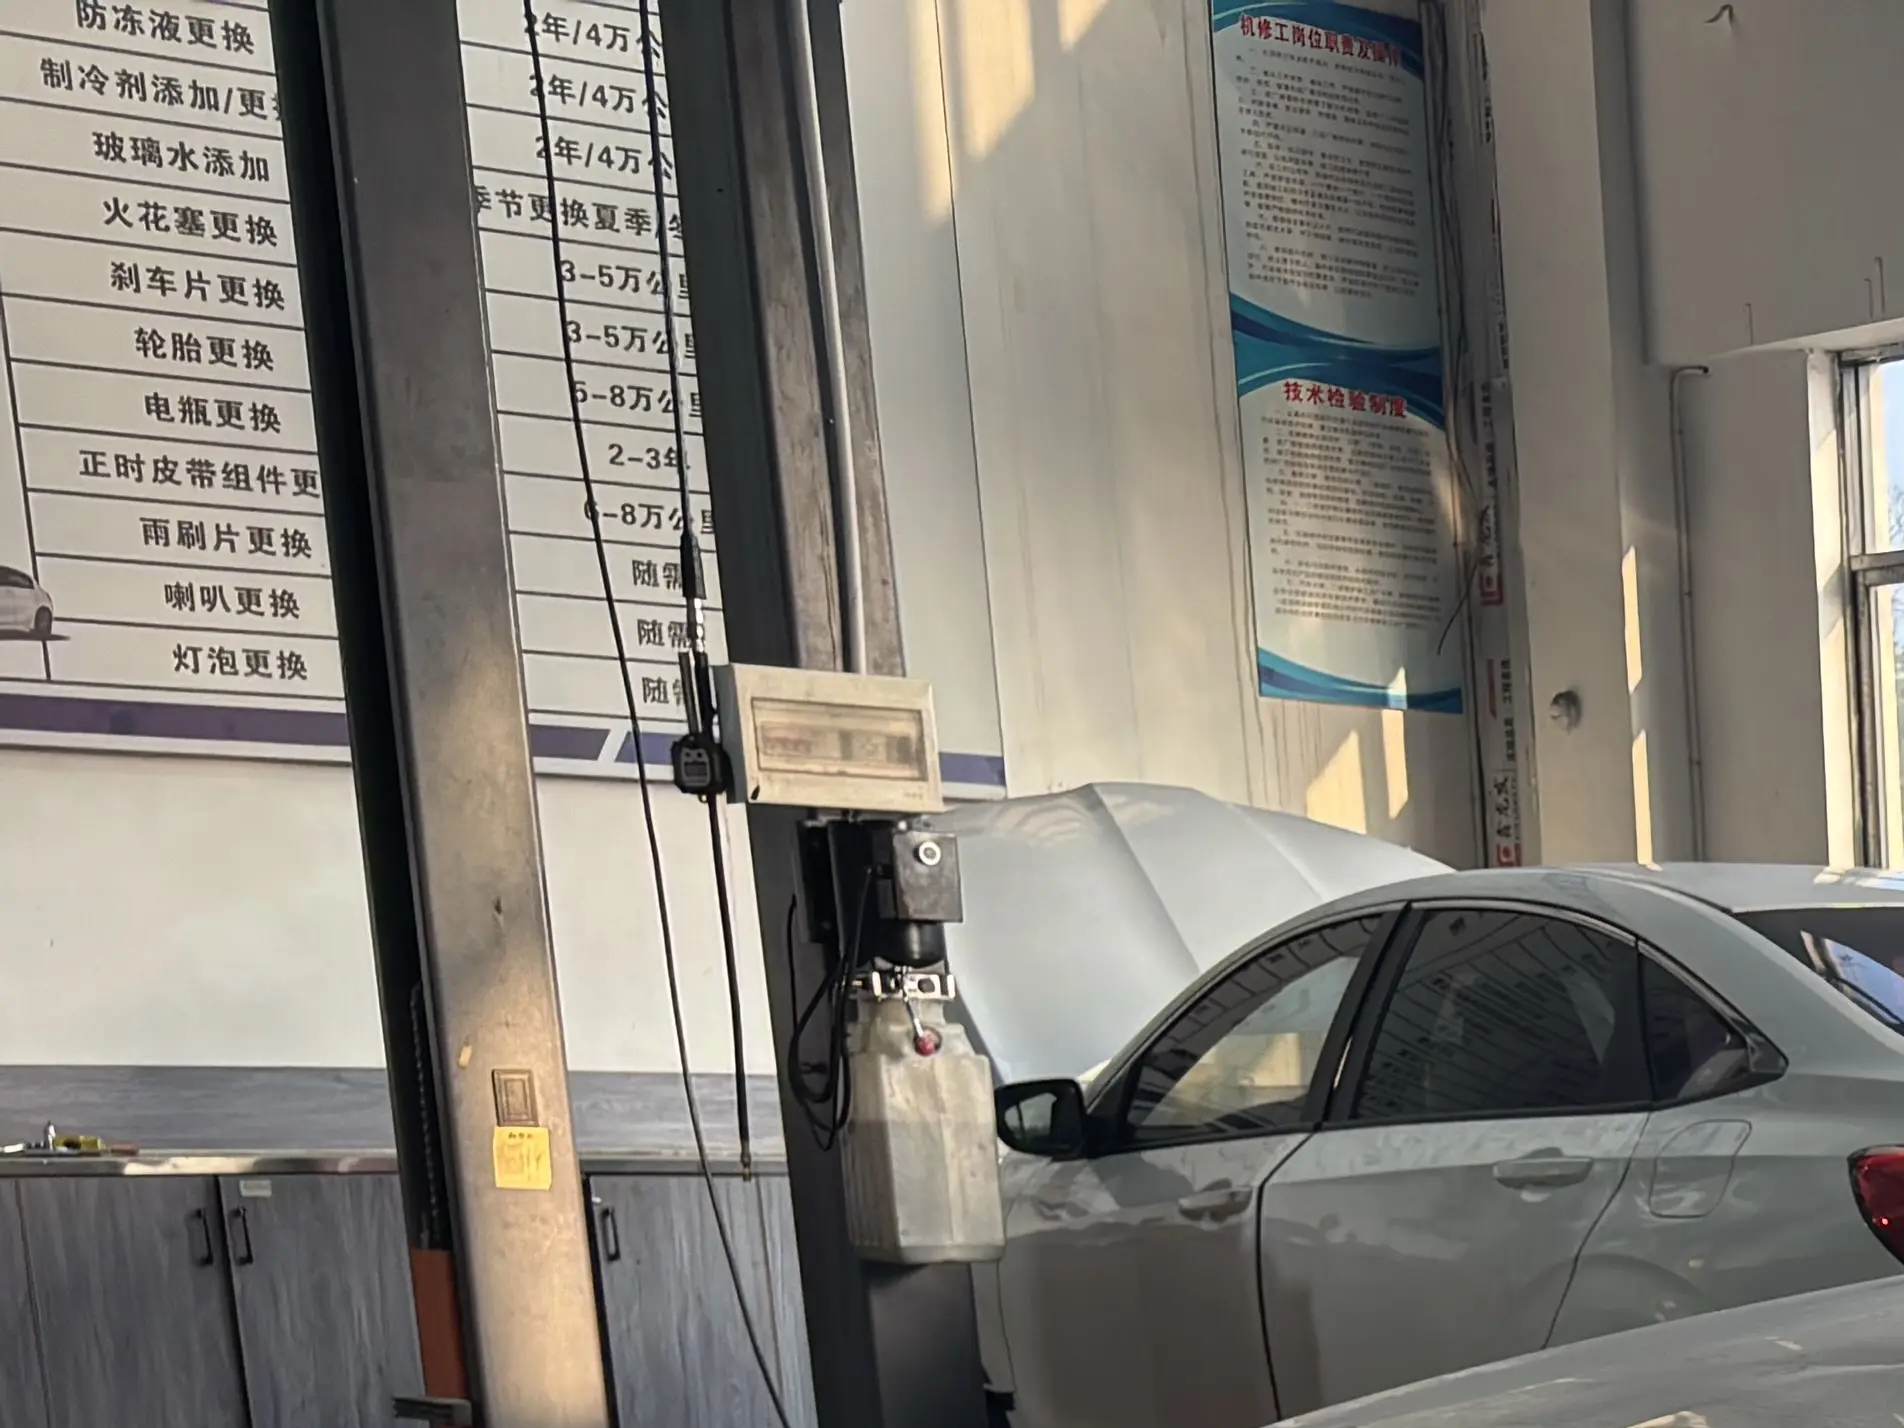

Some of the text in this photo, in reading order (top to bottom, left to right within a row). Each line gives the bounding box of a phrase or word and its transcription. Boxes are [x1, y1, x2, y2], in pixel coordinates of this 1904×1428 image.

[76, 0, 255, 55] 防冻液更换
[92, 131, 270, 182] 玻璃水添加
[103, 196, 278, 247] 火花塞更换
[111, 261, 286, 310] 刹车片更换
[134, 326, 275, 372] 轮胎更换
[144, 391, 281, 434] 电瓶更换
[1283, 381, 1407, 419] 技术检验制度
[139, 516, 313, 559] 雨刷片更换
[163, 581, 300, 620] 喇叭更换
[172, 643, 308, 681] 灯泡更换
